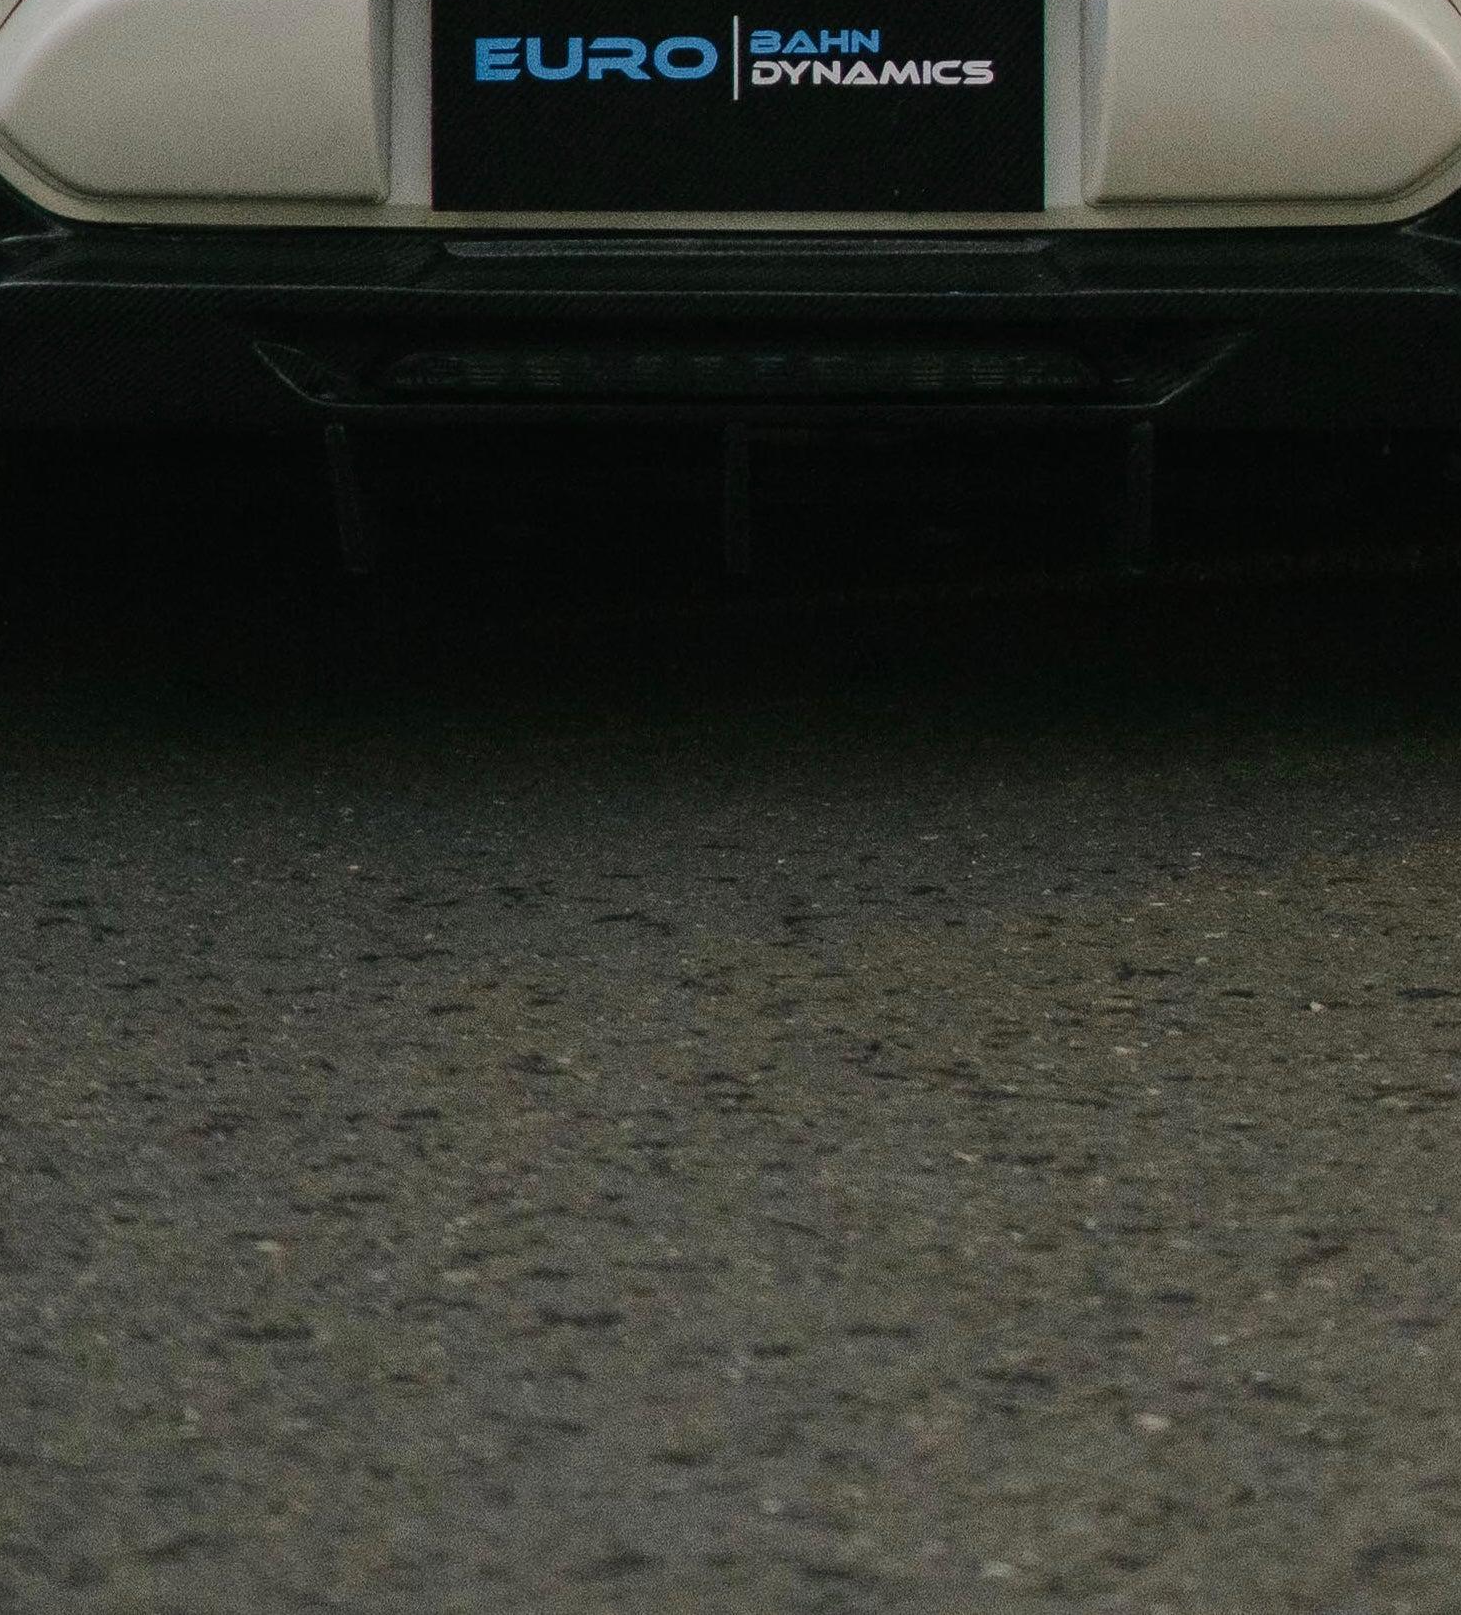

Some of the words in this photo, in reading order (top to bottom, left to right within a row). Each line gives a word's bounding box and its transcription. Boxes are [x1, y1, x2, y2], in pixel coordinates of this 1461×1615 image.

[749, 28, 881, 55] BAHN
[474, 36, 719, 82] EURO
[751, 58, 995, 86] DYNAMICS
